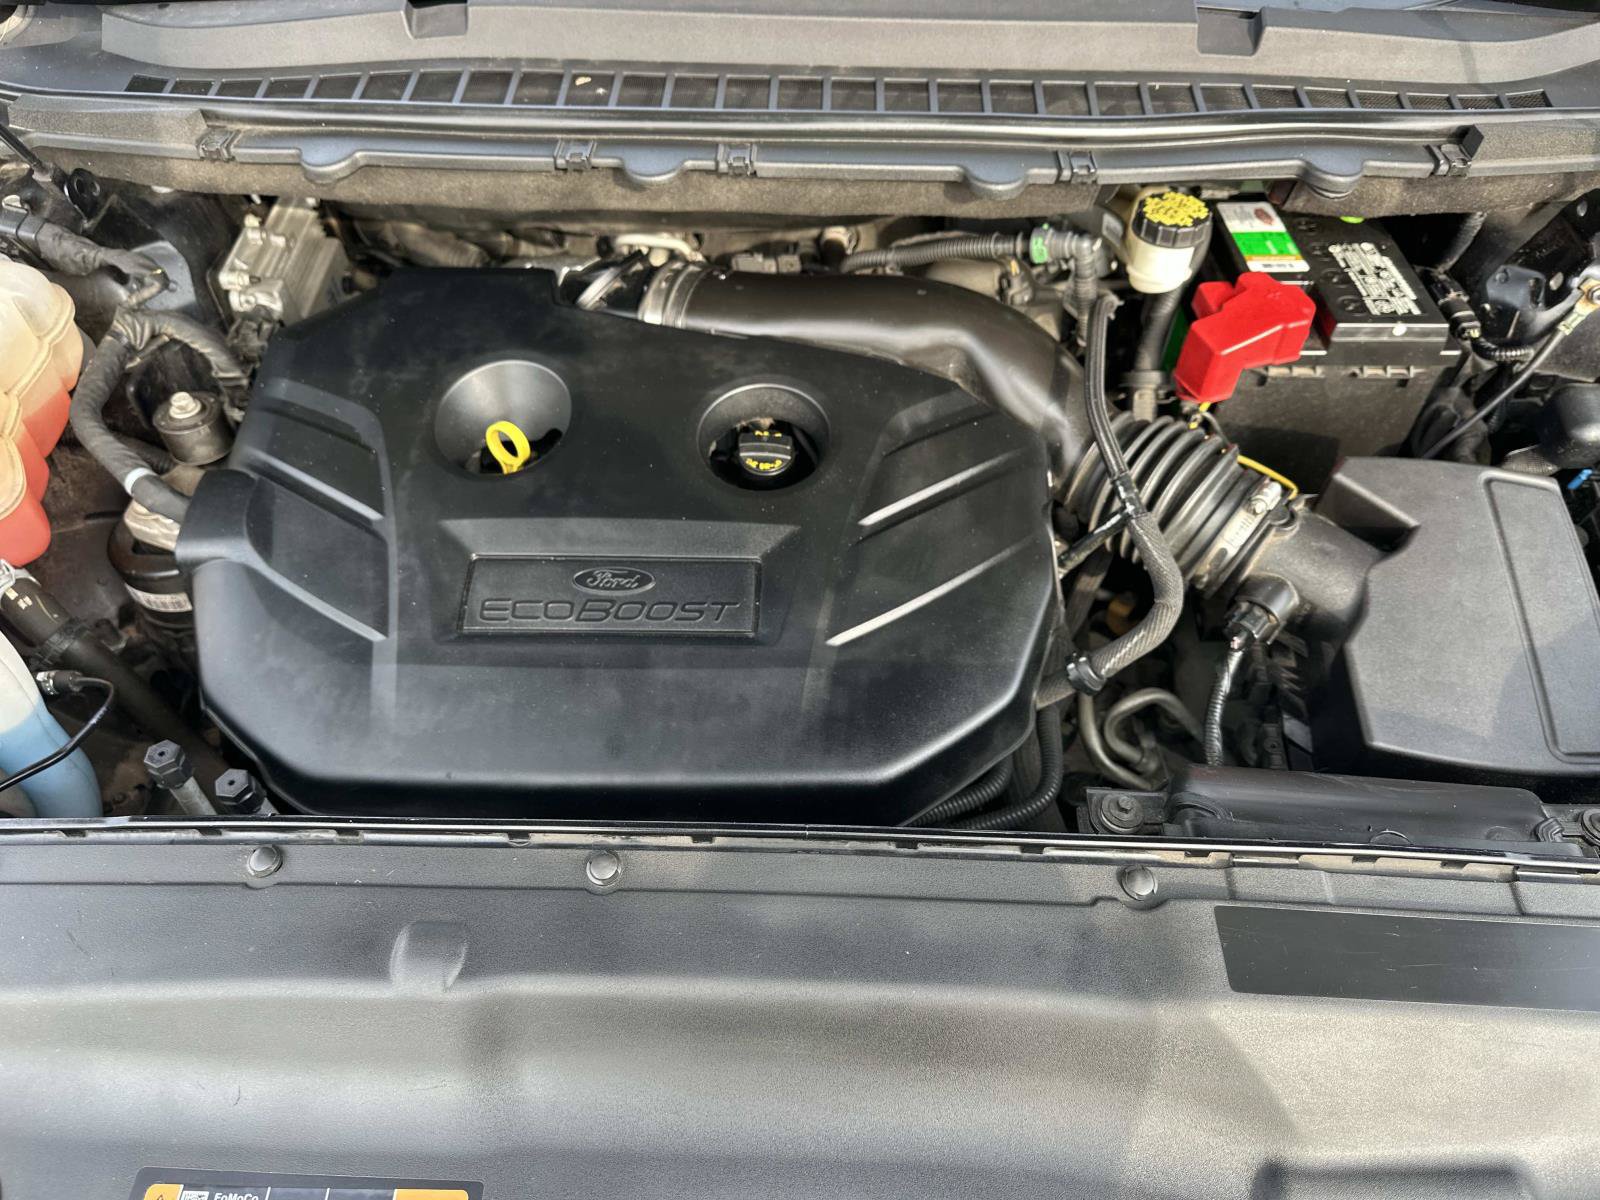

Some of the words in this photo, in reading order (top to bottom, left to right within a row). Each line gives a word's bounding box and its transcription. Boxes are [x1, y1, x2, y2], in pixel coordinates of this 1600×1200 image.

[586, 568, 639, 589] Ford
[479, 598, 740, 623] ECOBOOST
[213, 1192, 259, 1200] FoMoCo
